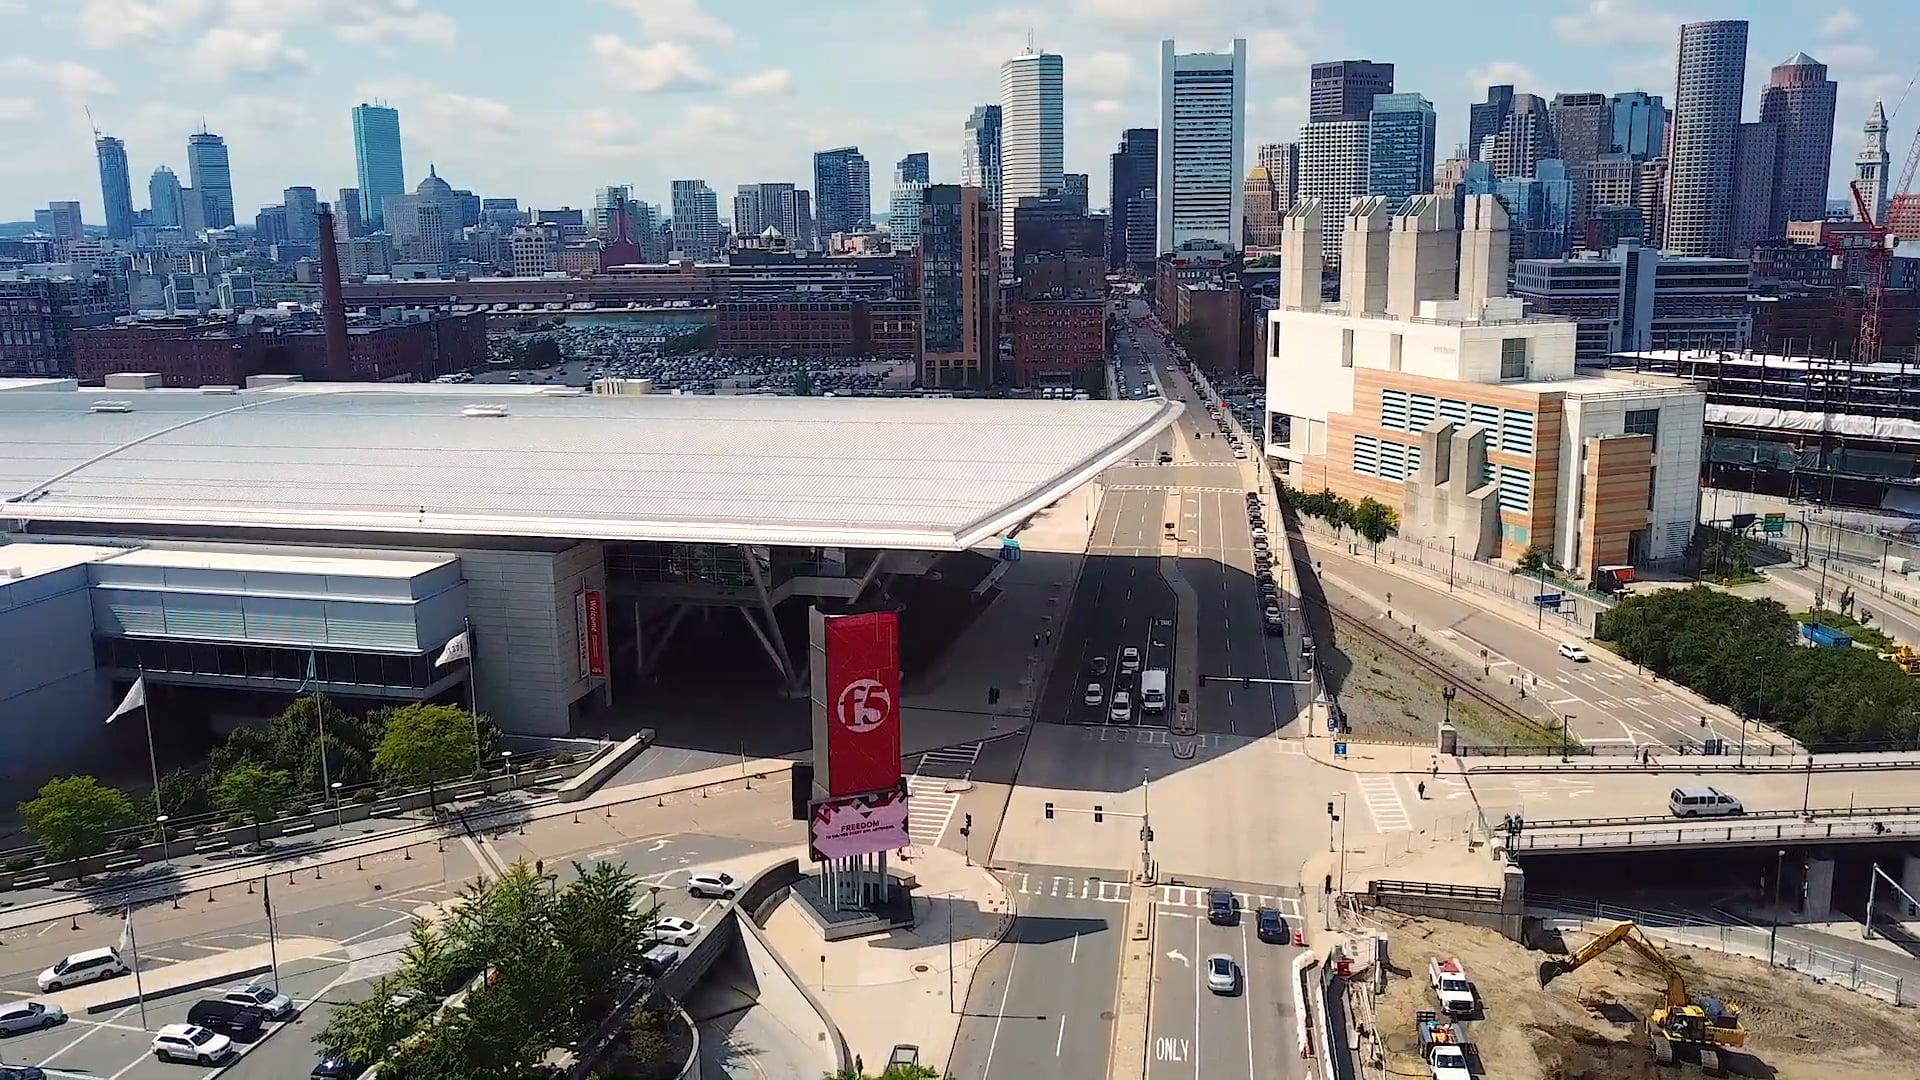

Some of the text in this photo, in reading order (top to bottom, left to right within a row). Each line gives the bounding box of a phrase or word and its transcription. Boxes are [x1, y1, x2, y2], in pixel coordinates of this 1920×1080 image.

[840, 686, 889, 726] f5
[841, 820, 880, 832] FREEDOM
[1156, 1036, 1189, 1062] ONLY
